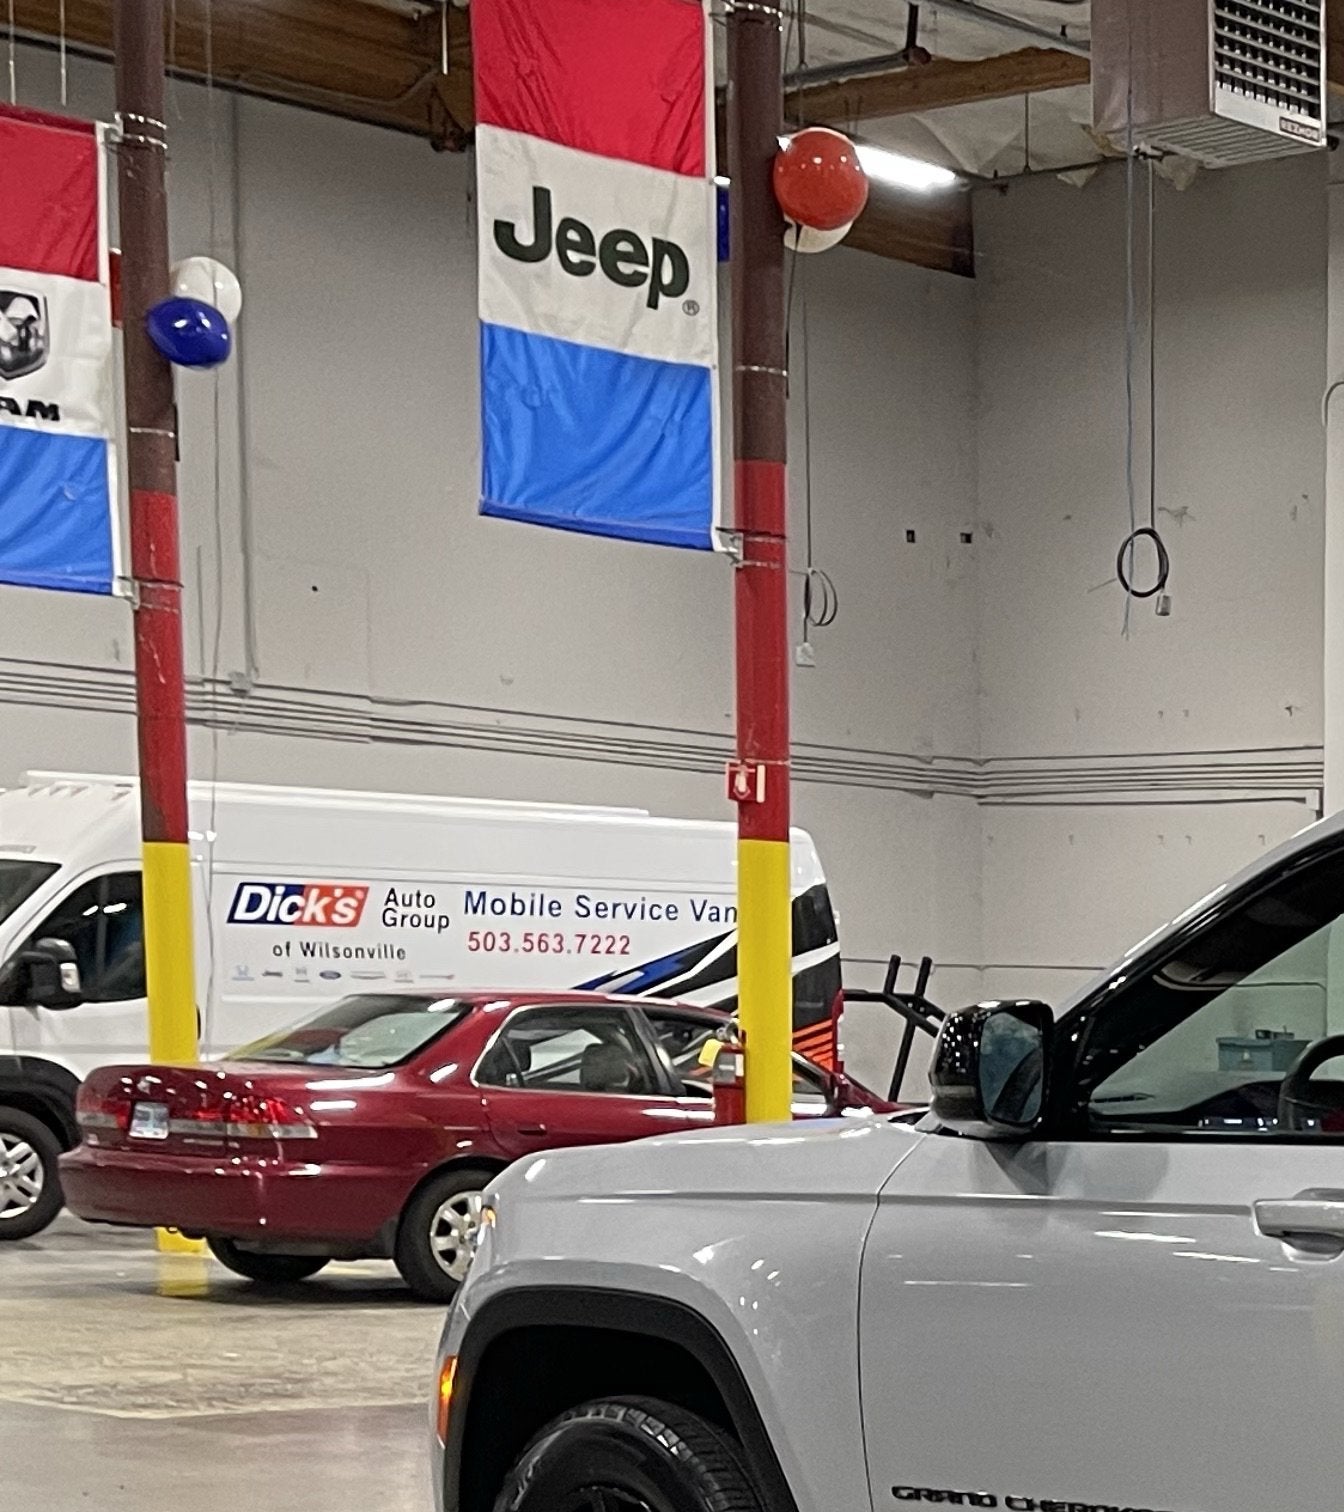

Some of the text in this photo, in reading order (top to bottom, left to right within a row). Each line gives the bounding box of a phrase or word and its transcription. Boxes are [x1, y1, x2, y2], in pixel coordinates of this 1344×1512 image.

[493, 185, 690, 311] Jeep
[0, 395, 60, 422] AM
[233, 884, 358, 924] Dick's
[384, 887, 436, 909] Auto
[464, 890, 738, 923] Mobile Service Van
[382, 907, 450, 934] Group
[272, 941, 407, 961] of Wilsonville
[467, 931, 631, 955] 503.563.7222
[891, 1485, 998, 1508] GRAND
